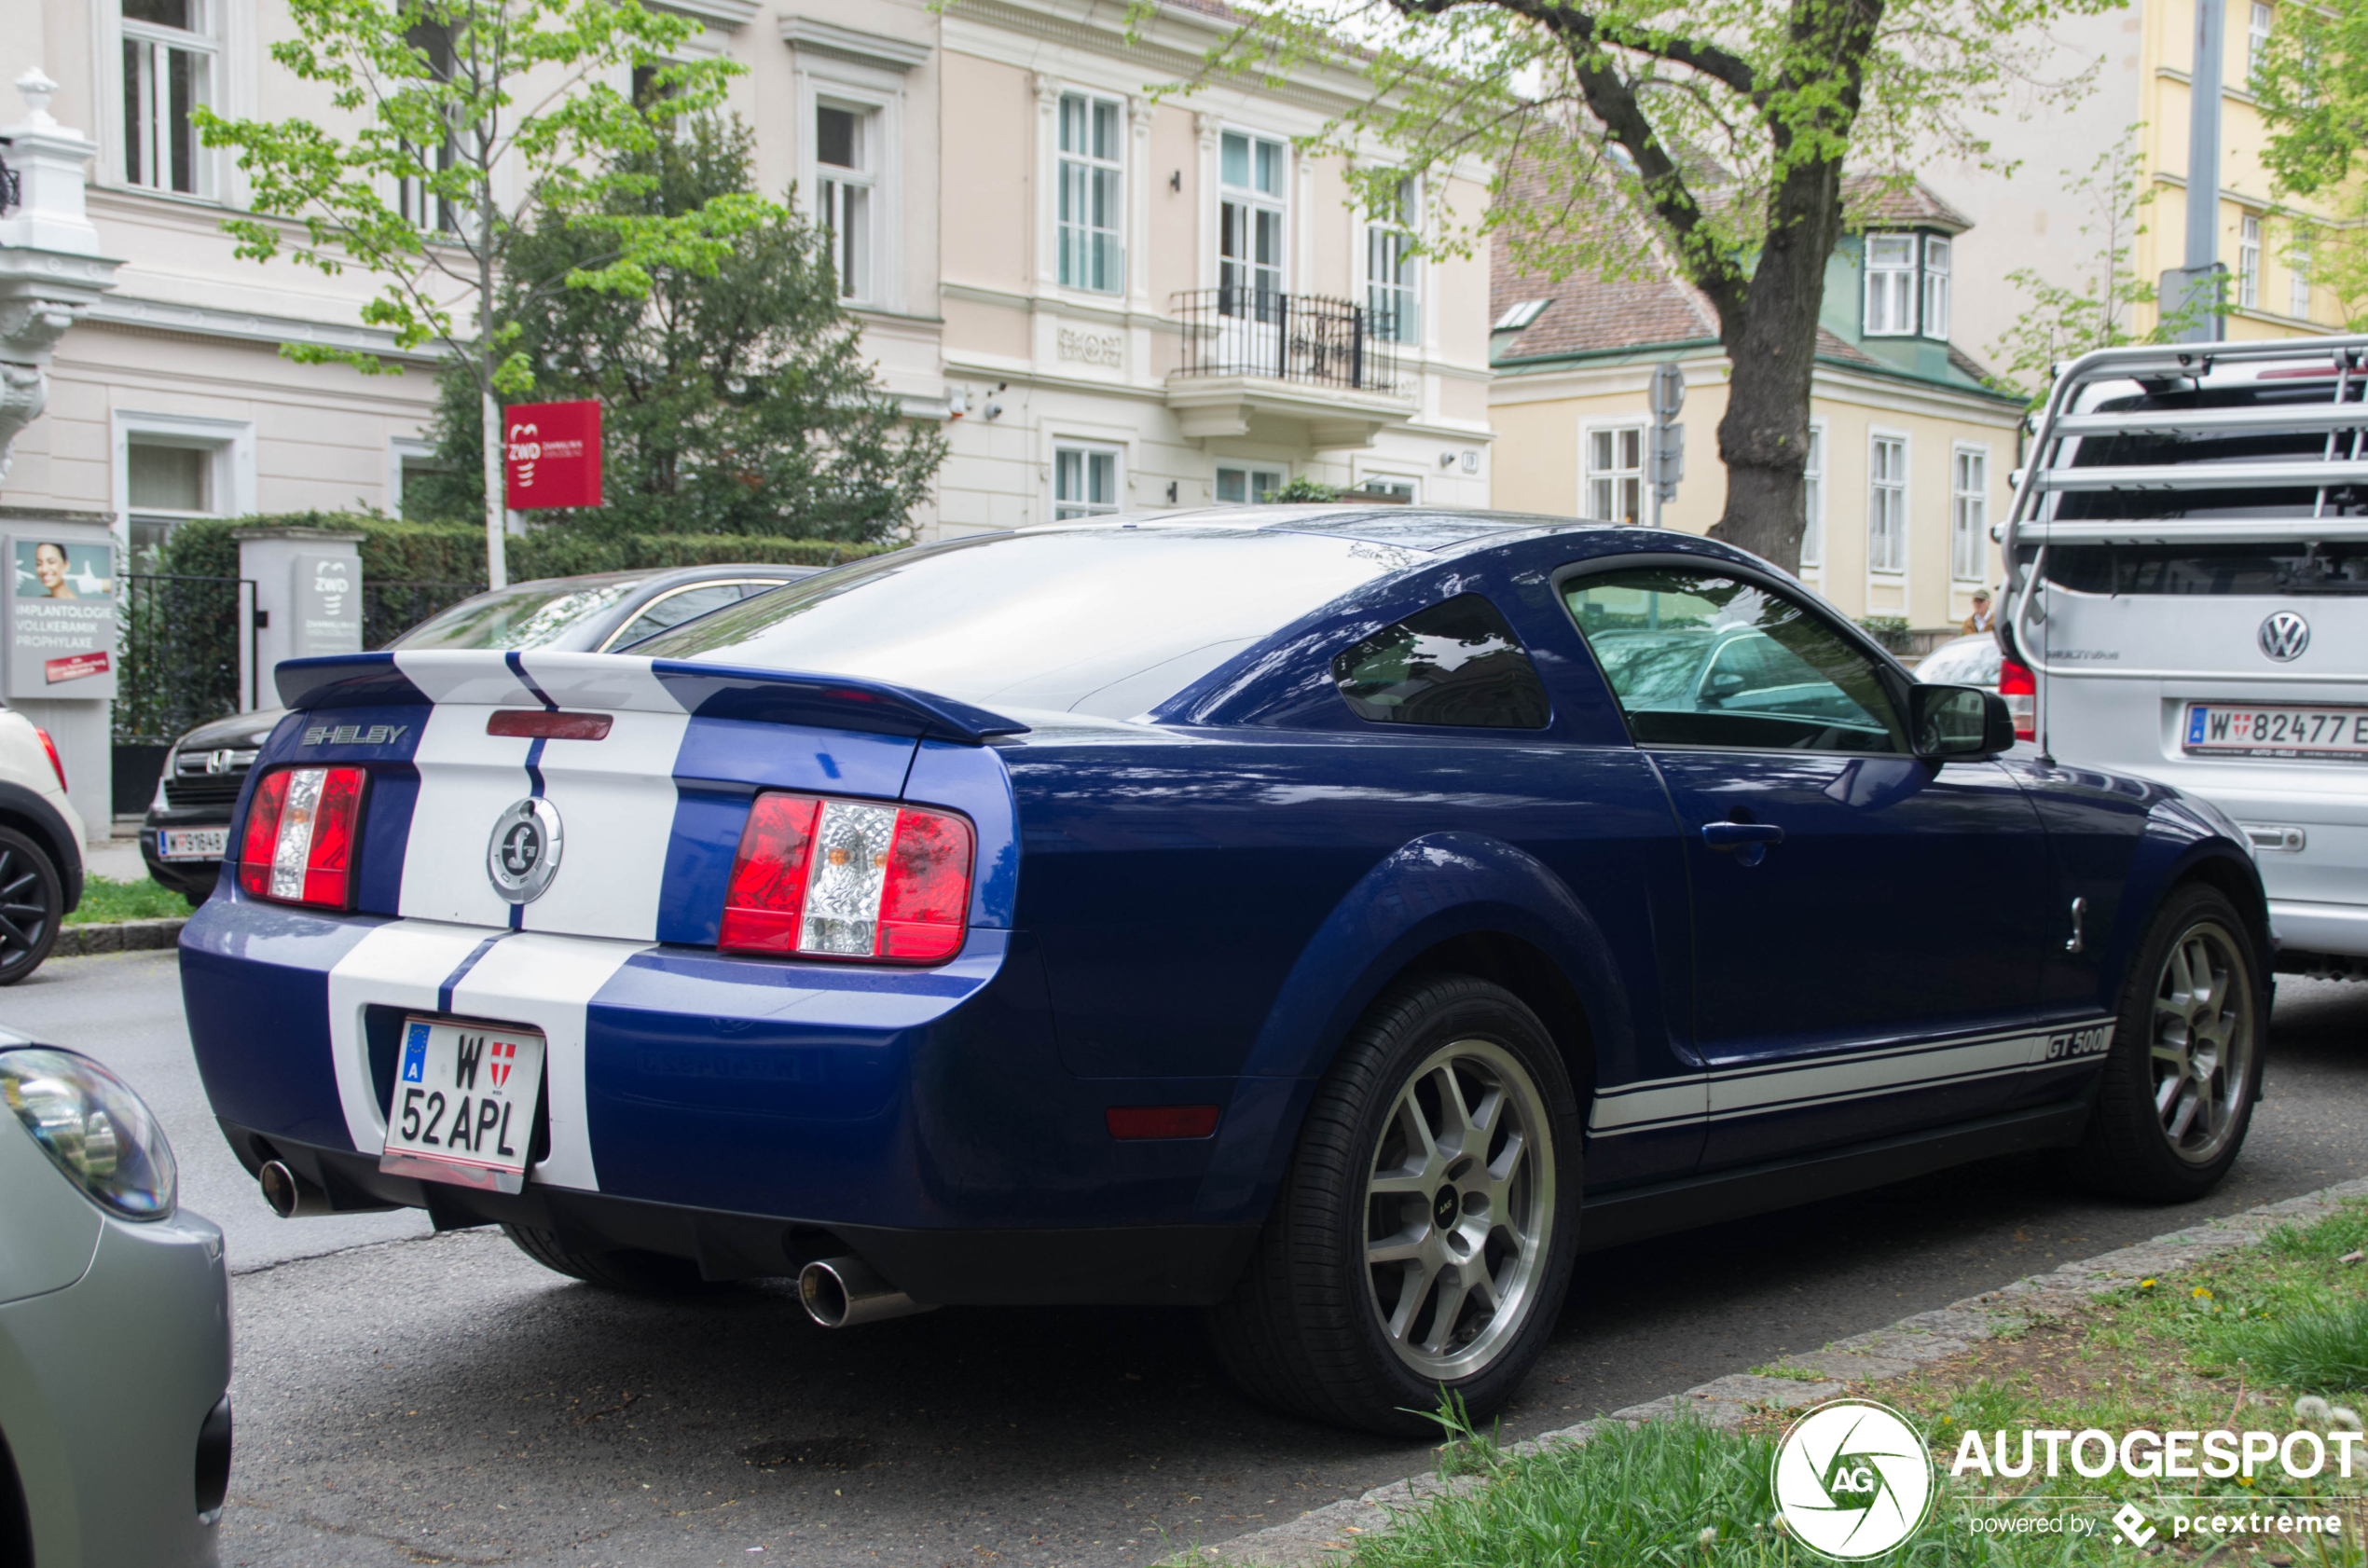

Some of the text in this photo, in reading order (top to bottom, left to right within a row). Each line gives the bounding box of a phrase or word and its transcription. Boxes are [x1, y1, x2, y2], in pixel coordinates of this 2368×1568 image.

[509, 442, 541, 461] ZWD
[314, 577, 350, 593] ZWD
[16, 604, 113, 619] IMPLANTOLOGIE
[16, 620, 98, 633] VOLLKERAMIK
[16, 635, 94, 649] PROPHYLAXE
[301, 725, 408, 746] SHELBY
[2210, 712, 2231, 741] W
[2252, 713, 2347, 743] 82477
[2047, 1027, 2103, 1059] GT 500
[406, 1062, 419, 1080] A
[455, 1033, 485, 1091] W
